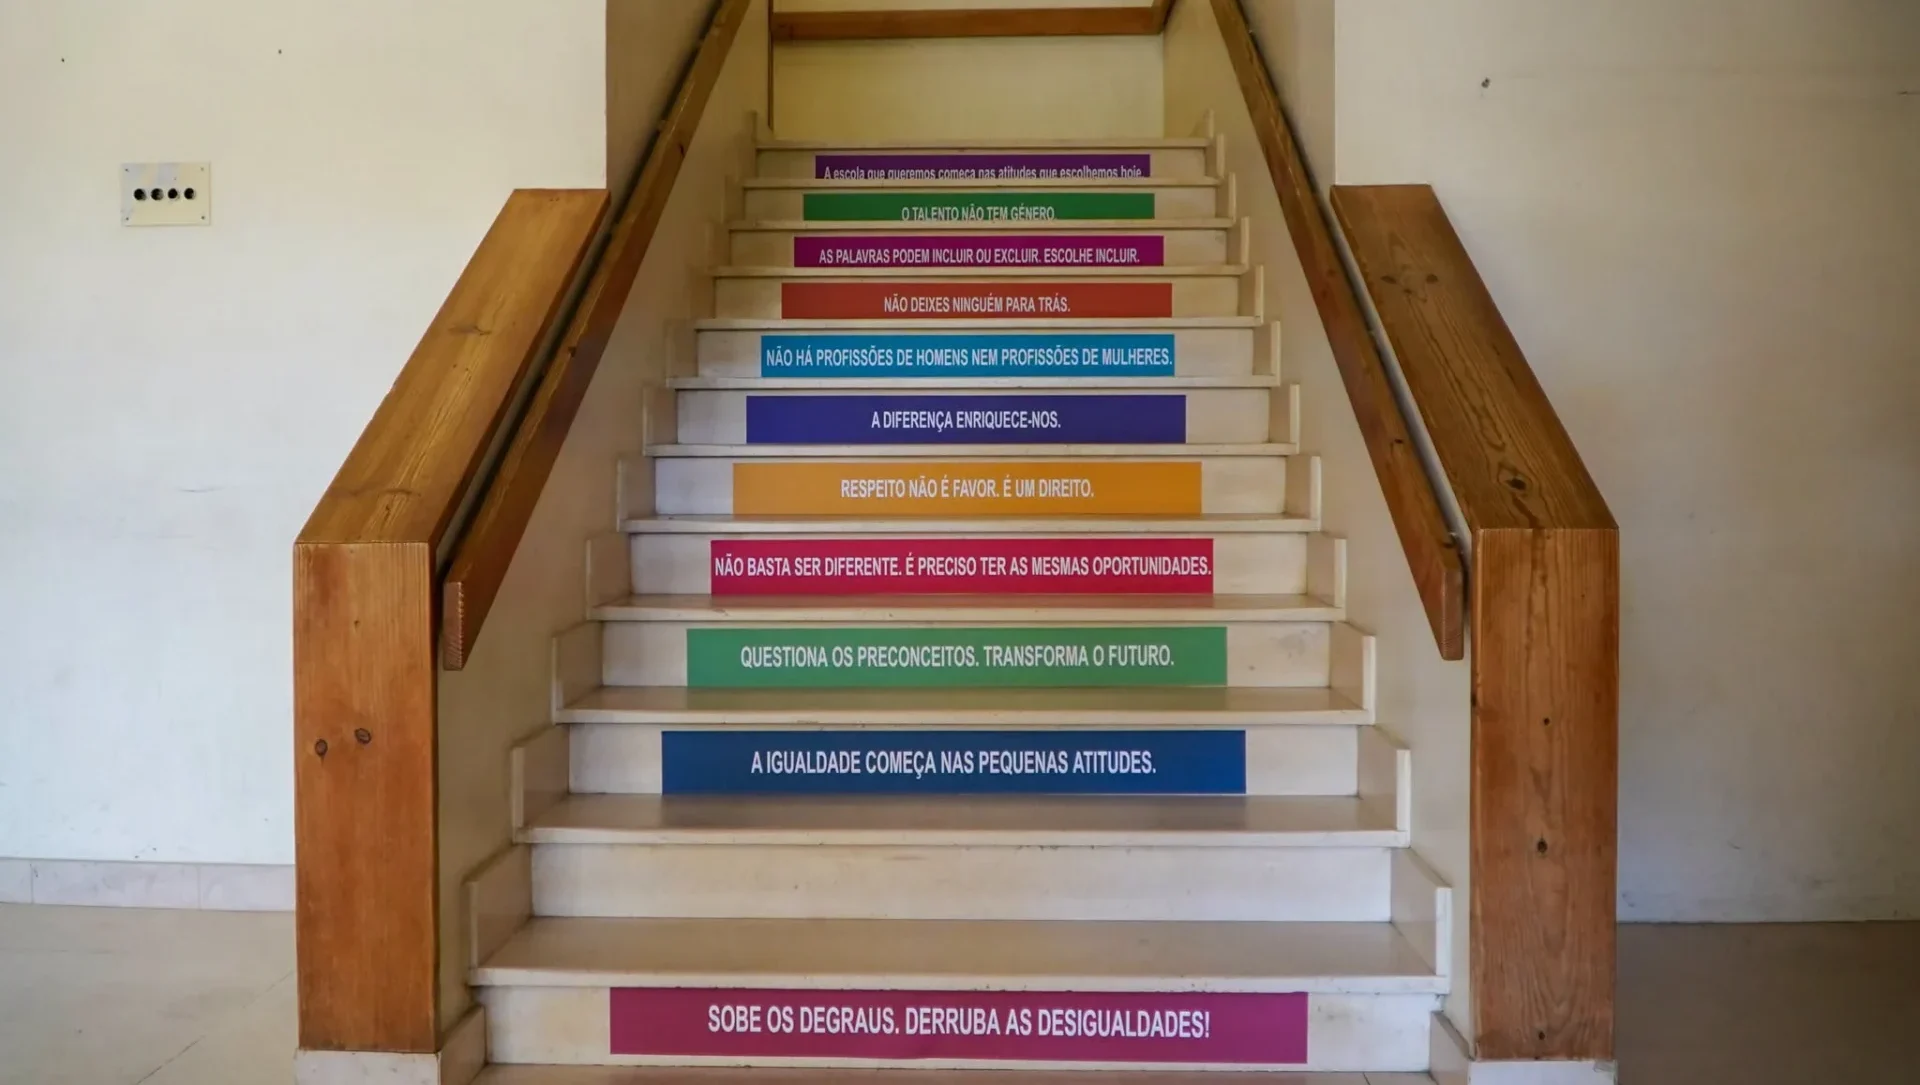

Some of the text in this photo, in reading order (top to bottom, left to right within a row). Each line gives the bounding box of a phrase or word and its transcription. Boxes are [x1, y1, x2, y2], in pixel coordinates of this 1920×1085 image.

[824, 166, 832, 179] A
[834, 166, 865, 179] escola
[867, 169, 885, 179] que
[887, 169, 935, 179] queremos
[978, 169, 996, 179] nas
[999, 166, 1036, 179] atitudes
[1039, 169, 1058, 178] que
[1060, 165, 1118, 178] escolhemos
[902, 207, 909, 220] O
[912, 207, 959, 220] TALENTO
[962, 204, 984, 220] NÃO
[987, 207, 1008, 220] TEM
[820, 248, 1139, 263] AS PALAVRAS PODEM INCLUIR OU EXCLUIR. ESCOLHE INCLUIR.
[884, 293, 1070, 312] NÃO DEIXES NINGUÉM PARA TRÁS.
[767, 345, 1172, 366] NÃO HÁ PROFISSÕES DE HOMENS NEM PROFISSÕES DE MULHERES.
[872, 411, 1060, 432] A DIFERENÇA ENRIQUECE-NOS.
[841, 476, 1093, 498] RESPEITO NÃO É FAVOR. É UM DIREITO.
[715, 552, 1211, 576] NÃO BASTA SER DIFERENTE. É PRECISO TER AS MESMAS OPORTUNIDADES.
[741, 645, 1174, 668] QUESTIONA OS PRECONCEITOS. TRANSFORMA O FUTURO.
[751, 751, 1156, 779] A IGUALDADE COMEÇA NAS PEQUENAS ATITUDES.
[708, 1005, 1209, 1038] SOBE OS DEGRAUS. DERRUBA AS DESIGUALDADES!
